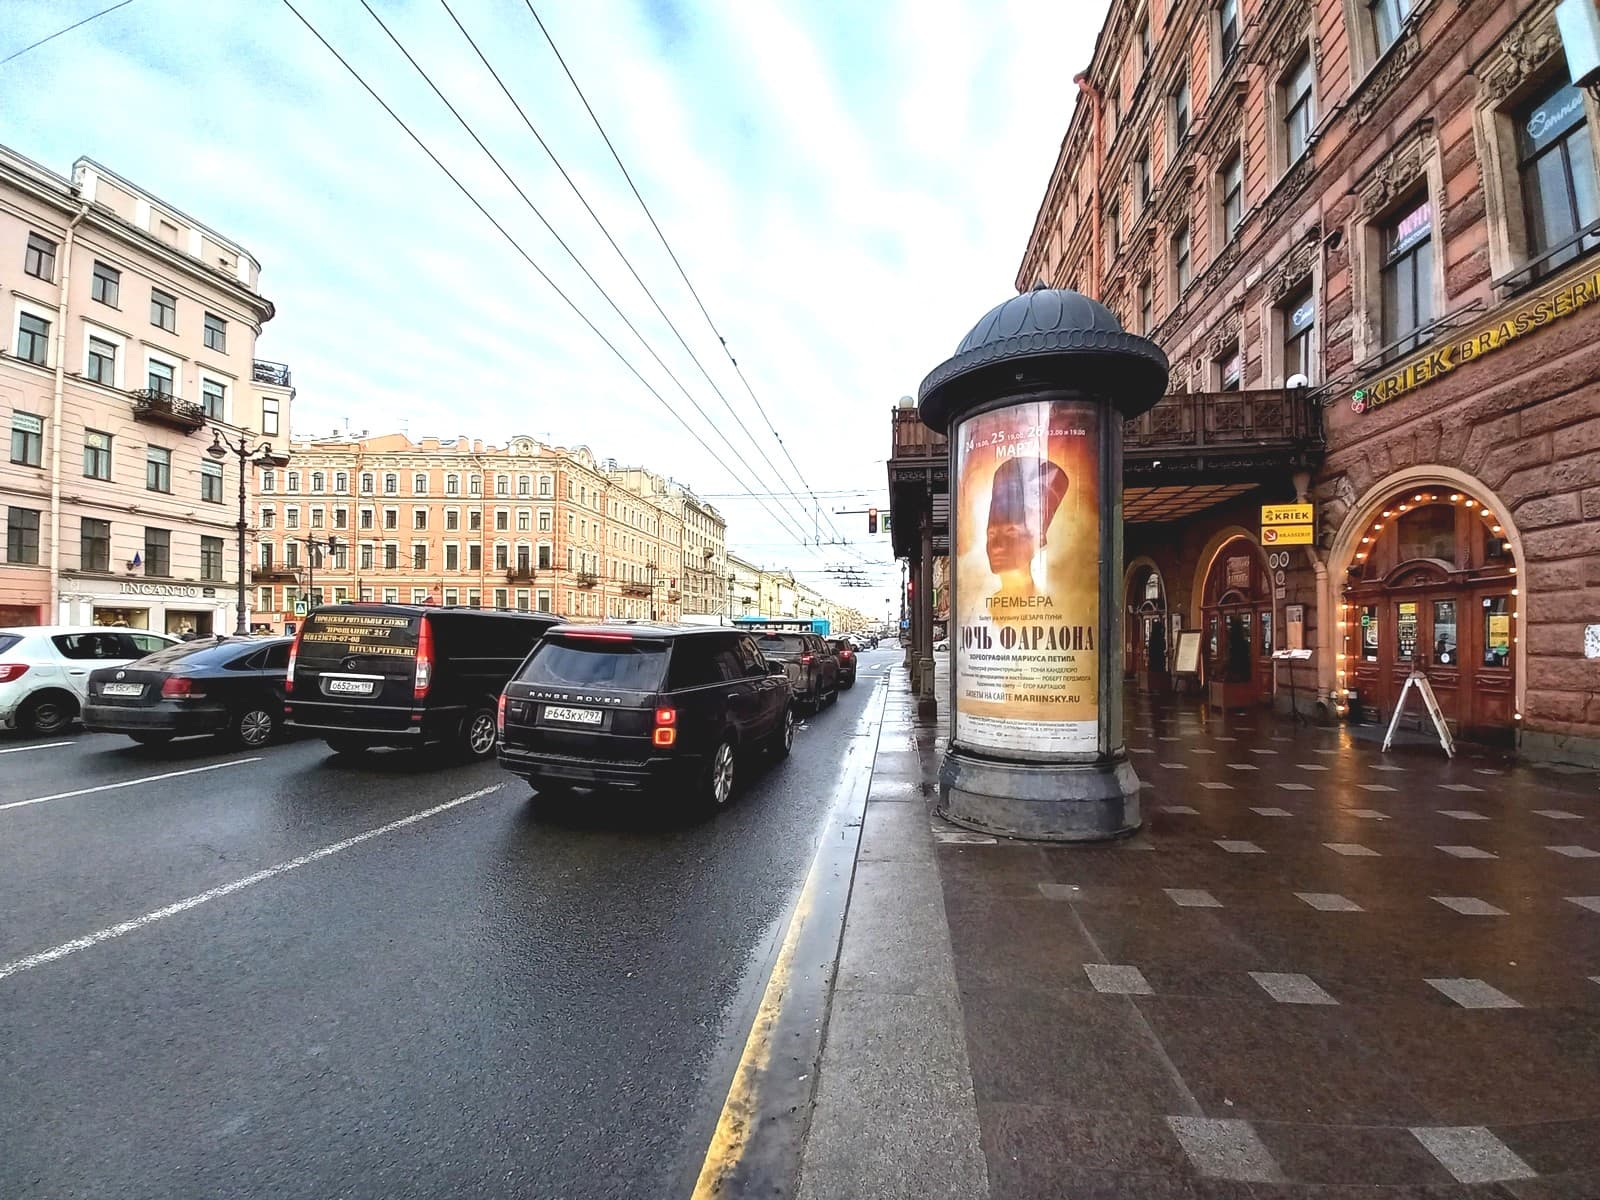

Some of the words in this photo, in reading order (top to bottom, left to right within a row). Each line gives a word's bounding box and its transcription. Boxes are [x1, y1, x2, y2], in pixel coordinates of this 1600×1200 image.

[1366, 347, 1455, 408] KRIEK
[991, 431, 1005, 444] 25
[996, 441, 1040, 458] МАРТА
[1275, 512, 1309, 520] KRIEK
[120, 582, 198, 597] INCANTO
[985, 596, 1054, 608] ПРЕМЬЕРА
[374, 629, 391, 637] 24/7
[960, 625, 993, 653] ДОЧЬ
[1000, 625, 1094, 651] ФАРАОНА
[348, 645, 417, 656] RITUALPITER.RU
[1011, 655, 1046, 663] МАРИУСА
[529, 691, 569, 700] RANGE
[576, 695, 621, 704] ROVER
[984, 691, 992, 699] НА
[993, 691, 1012, 700] САЙТЕ
[1014, 694, 1081, 703] MARIINSKY.RU
